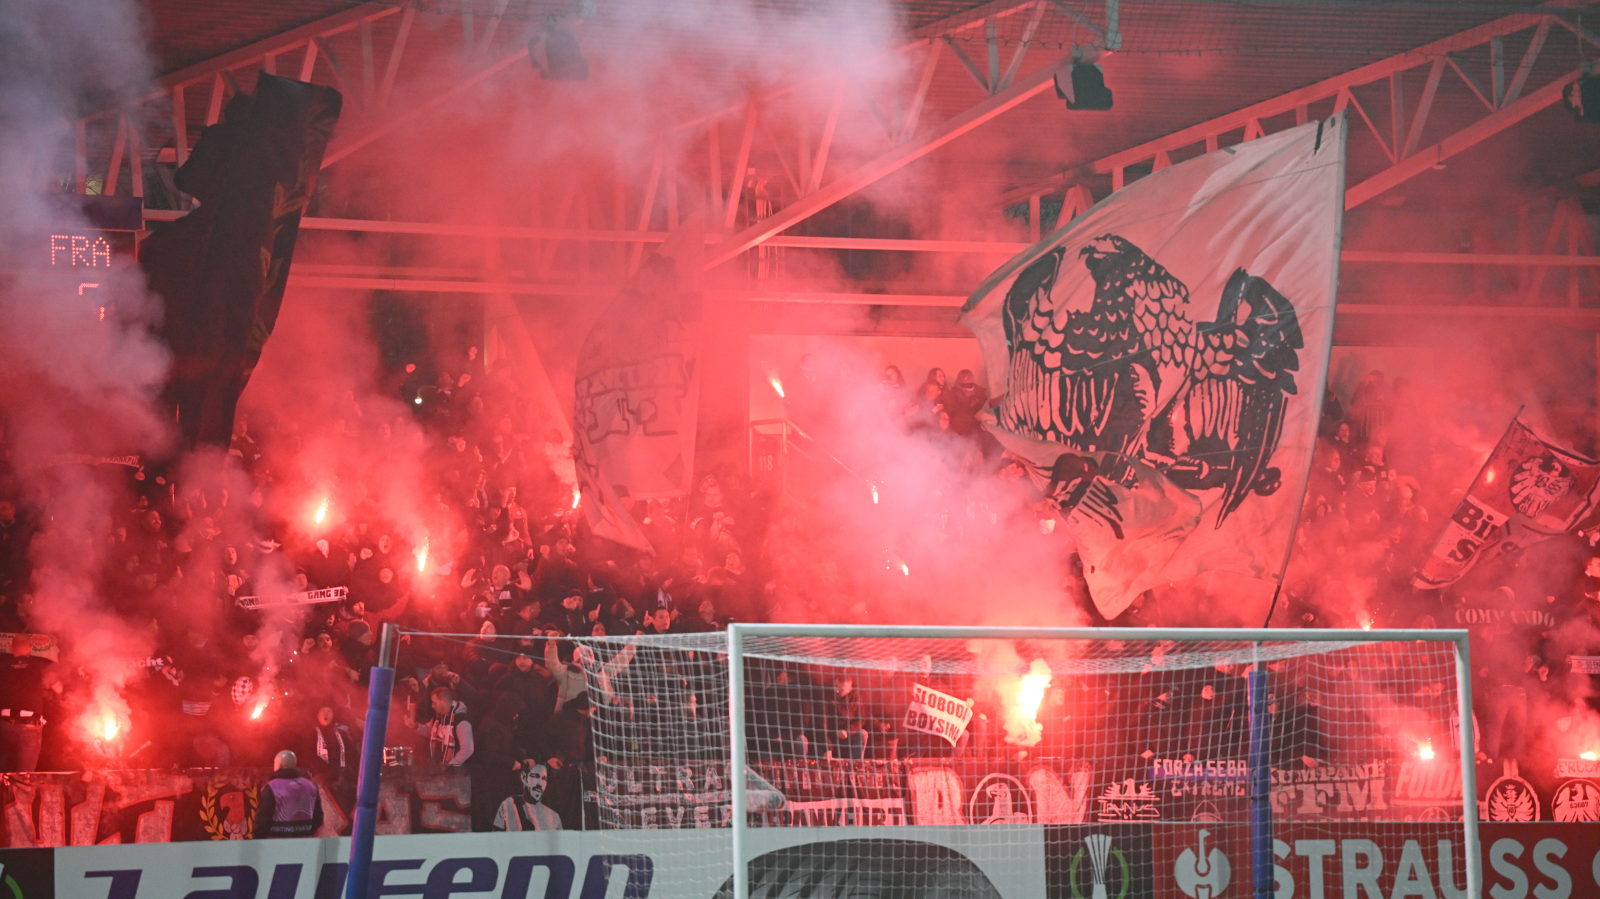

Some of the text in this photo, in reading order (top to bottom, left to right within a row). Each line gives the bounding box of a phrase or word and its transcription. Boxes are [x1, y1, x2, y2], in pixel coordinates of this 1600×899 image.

[50, 234, 111, 268] FRA
[759, 455, 773, 471] 118
[913, 686, 969, 723] SLOBODA
[597, 765, 731, 793] ULTRA
[1153, 758, 1247, 777] FORZA SEBA
[1273, 837, 1573, 899] STRAUSS
